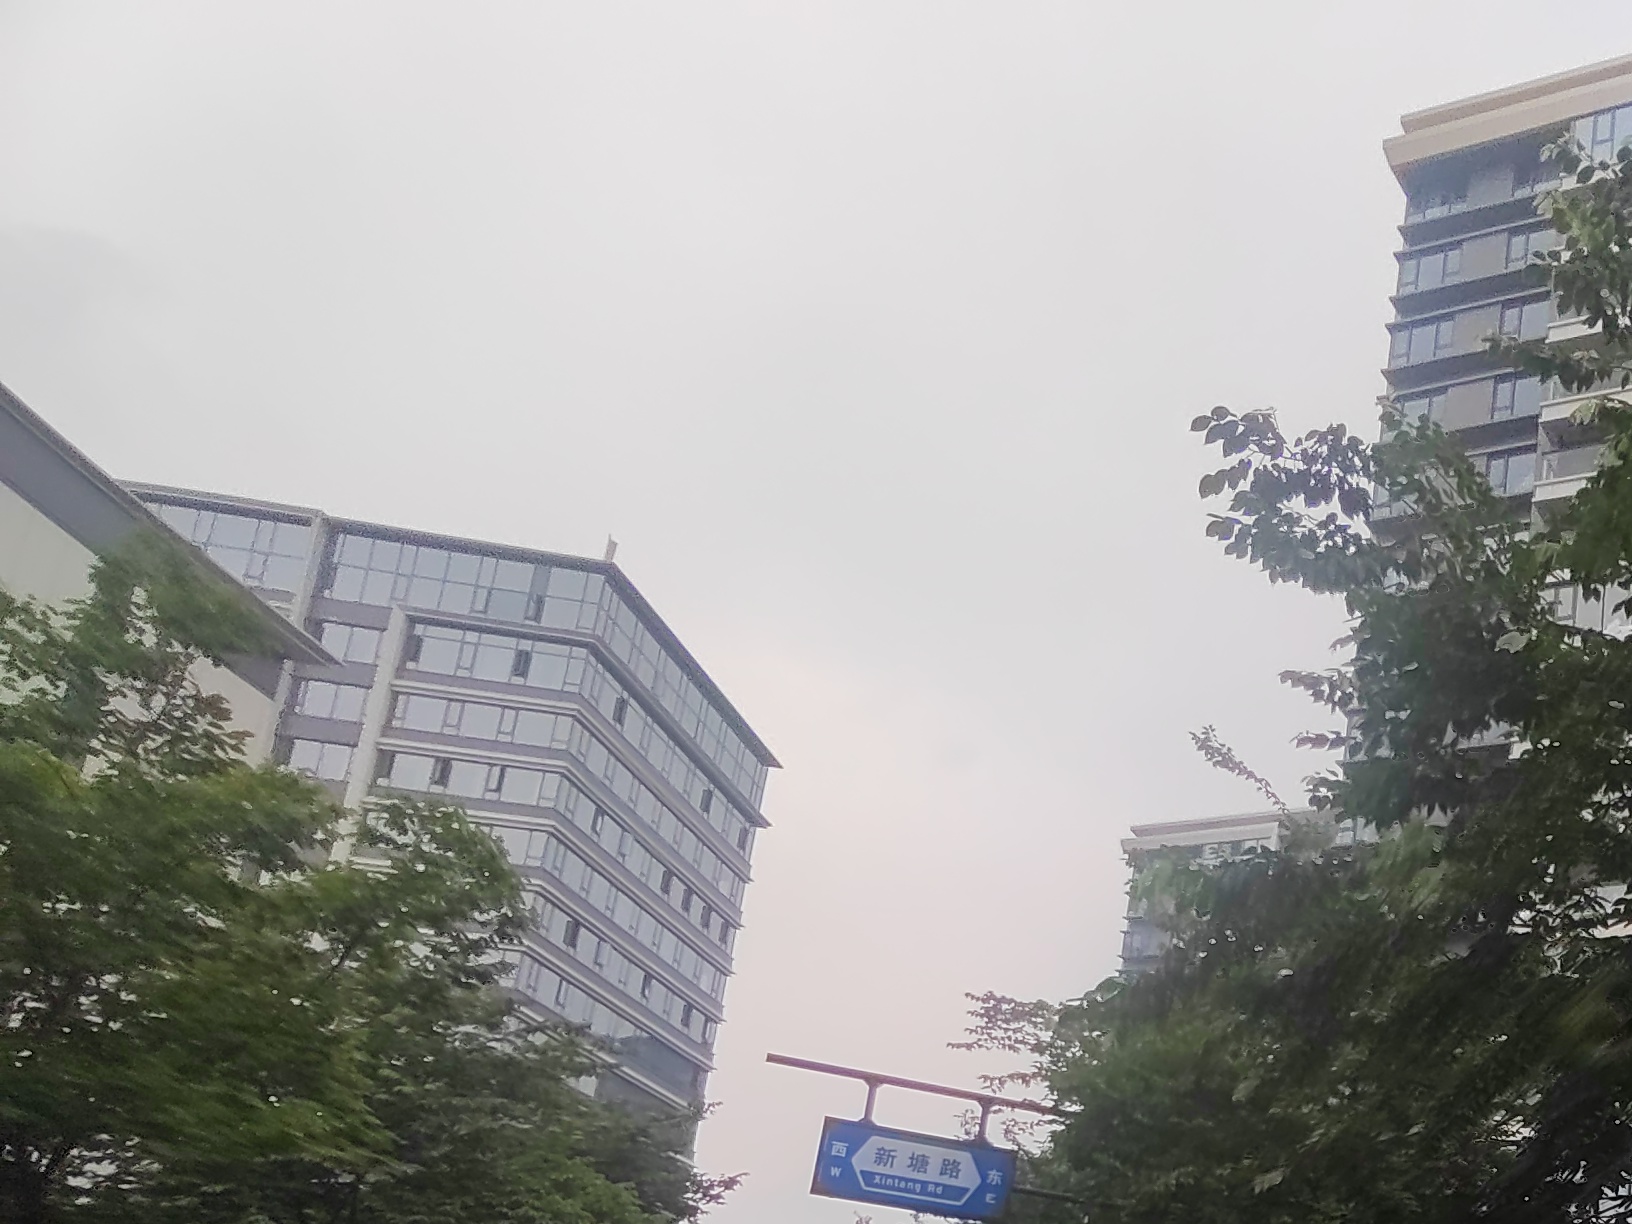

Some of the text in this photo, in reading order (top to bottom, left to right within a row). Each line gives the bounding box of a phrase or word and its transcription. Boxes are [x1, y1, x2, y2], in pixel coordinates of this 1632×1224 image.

[831, 1141, 849, 1157] 西
[873, 1146, 961, 1179] 新塘路
[830, 1166, 842, 1177] W
[986, 1169, 1003, 1185] 东
[873, 1174, 943, 1194] Xintang Rd
[985, 1193, 996, 1204] E
